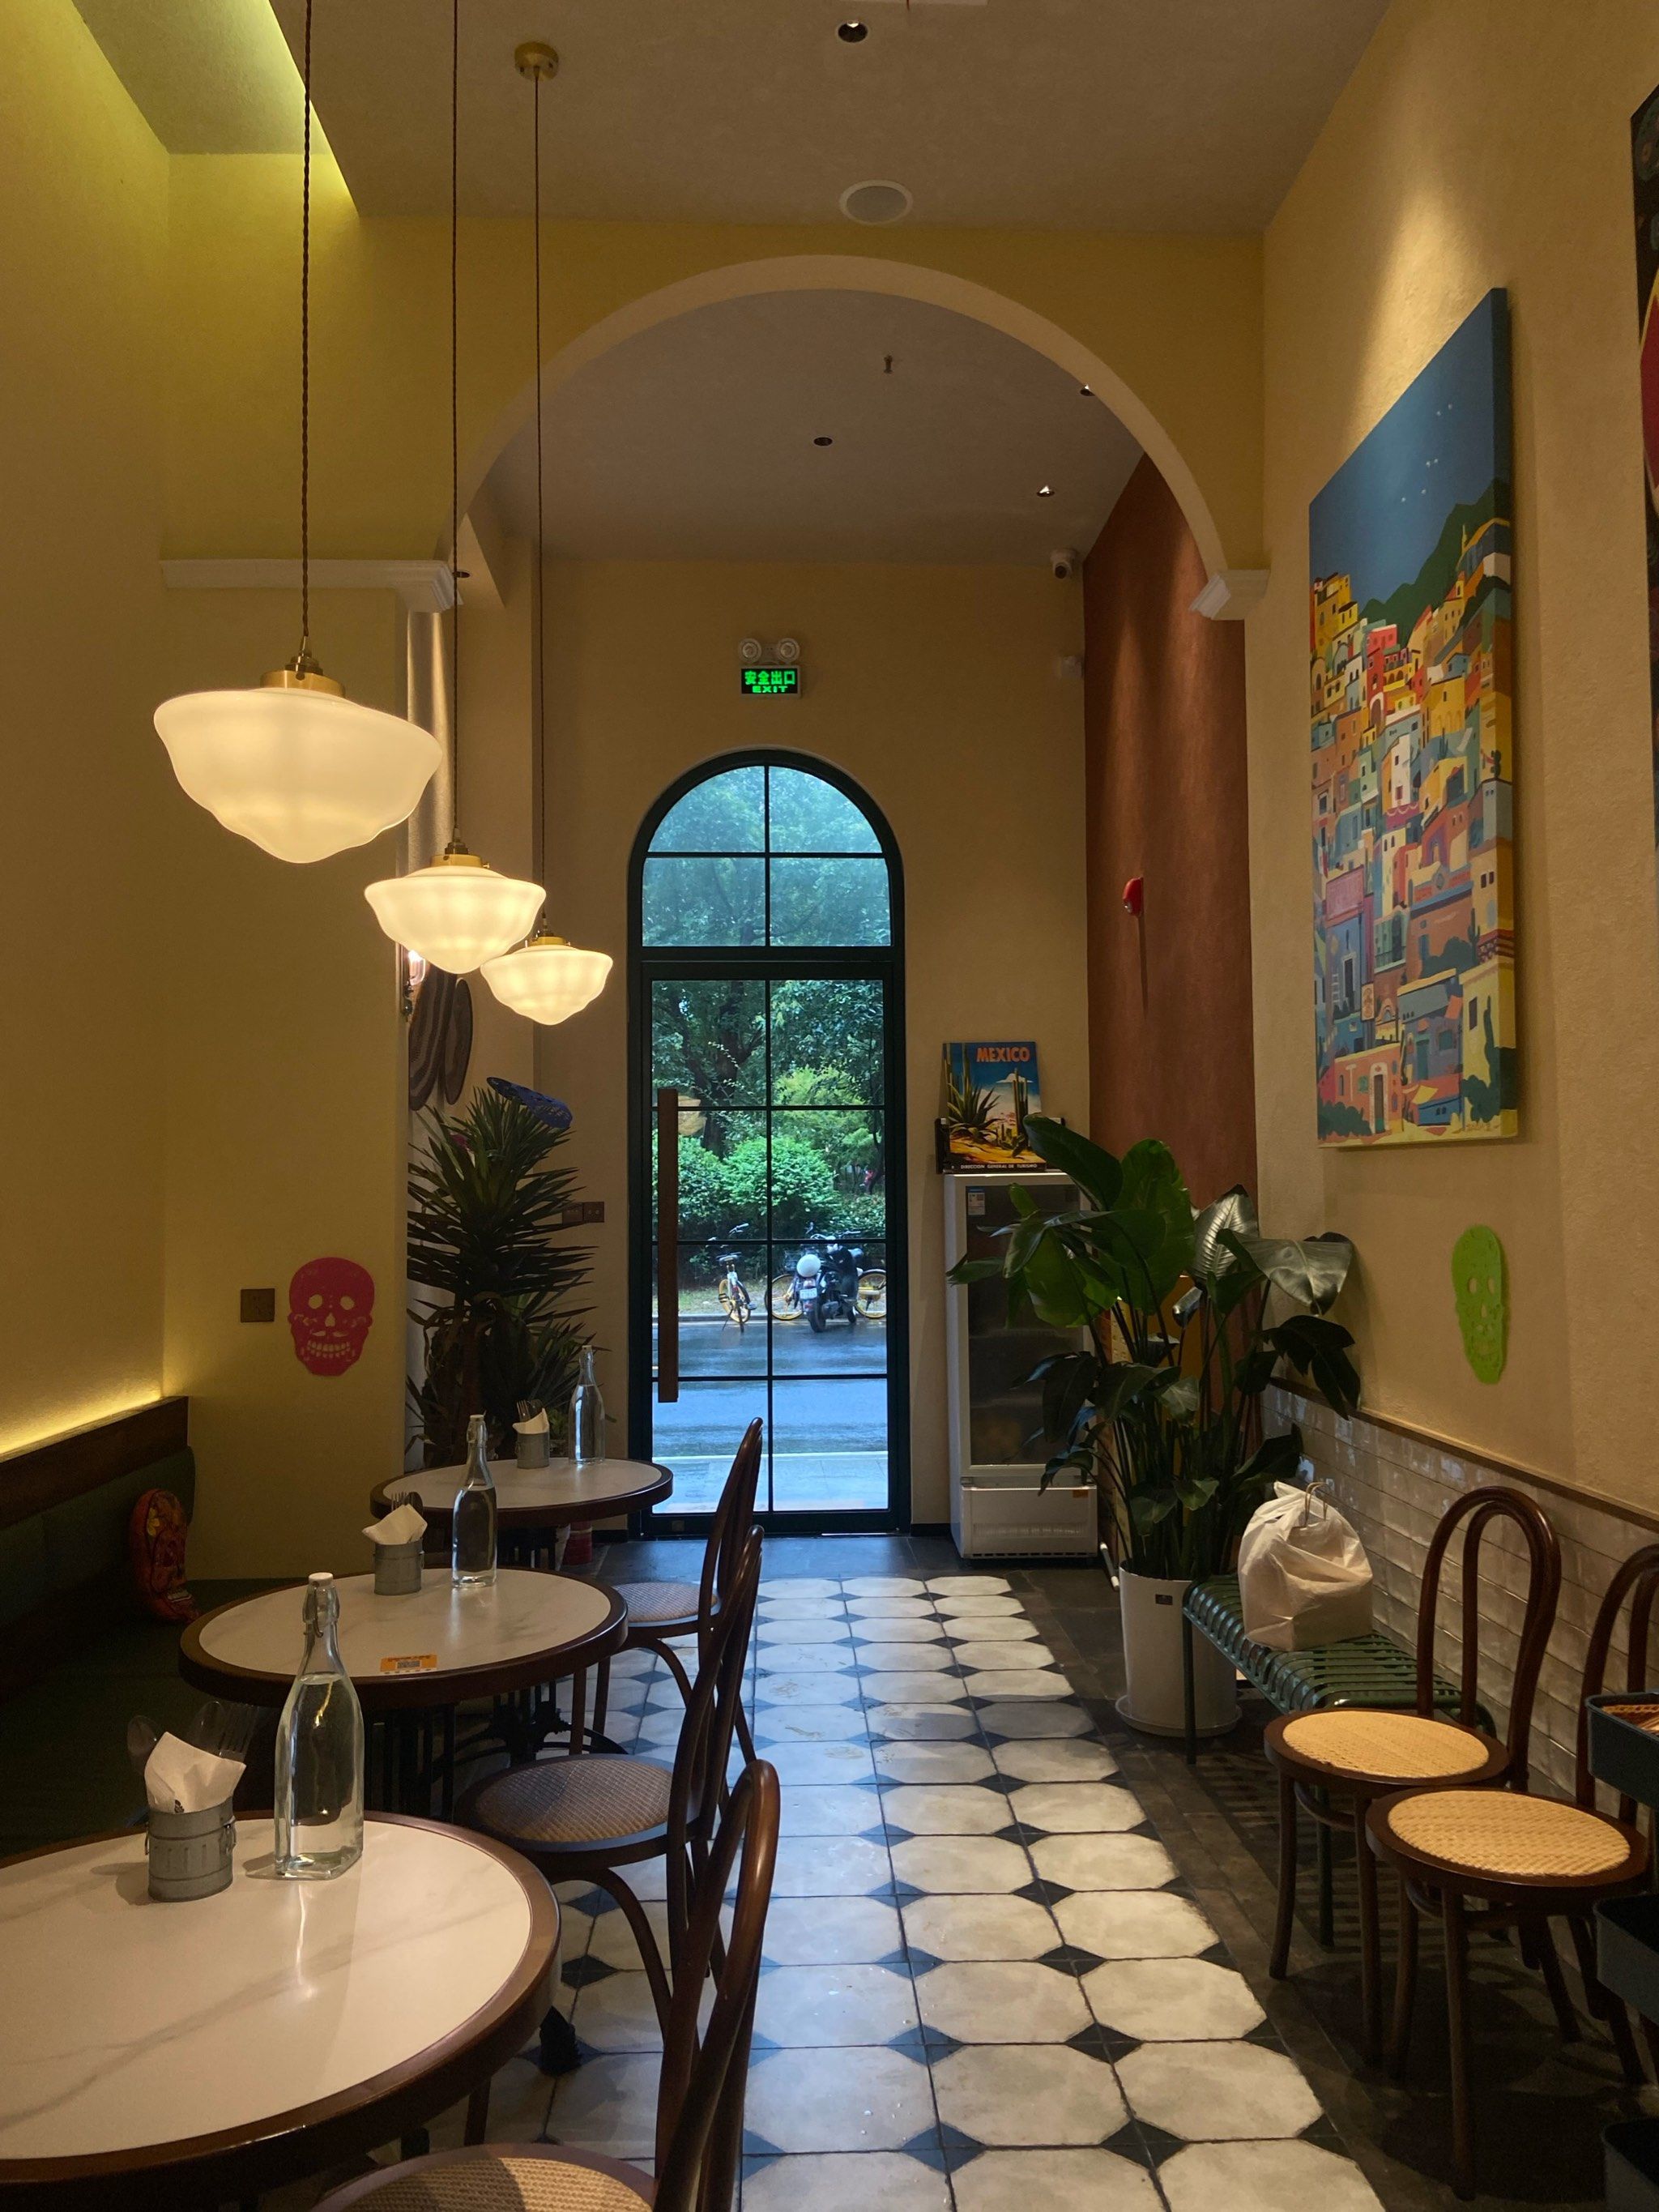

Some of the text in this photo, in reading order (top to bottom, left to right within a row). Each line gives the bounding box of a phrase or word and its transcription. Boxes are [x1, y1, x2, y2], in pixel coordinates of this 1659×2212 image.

[744, 671, 795, 685] 安全出口
[977, 1047, 1030, 1062] MEXICO
